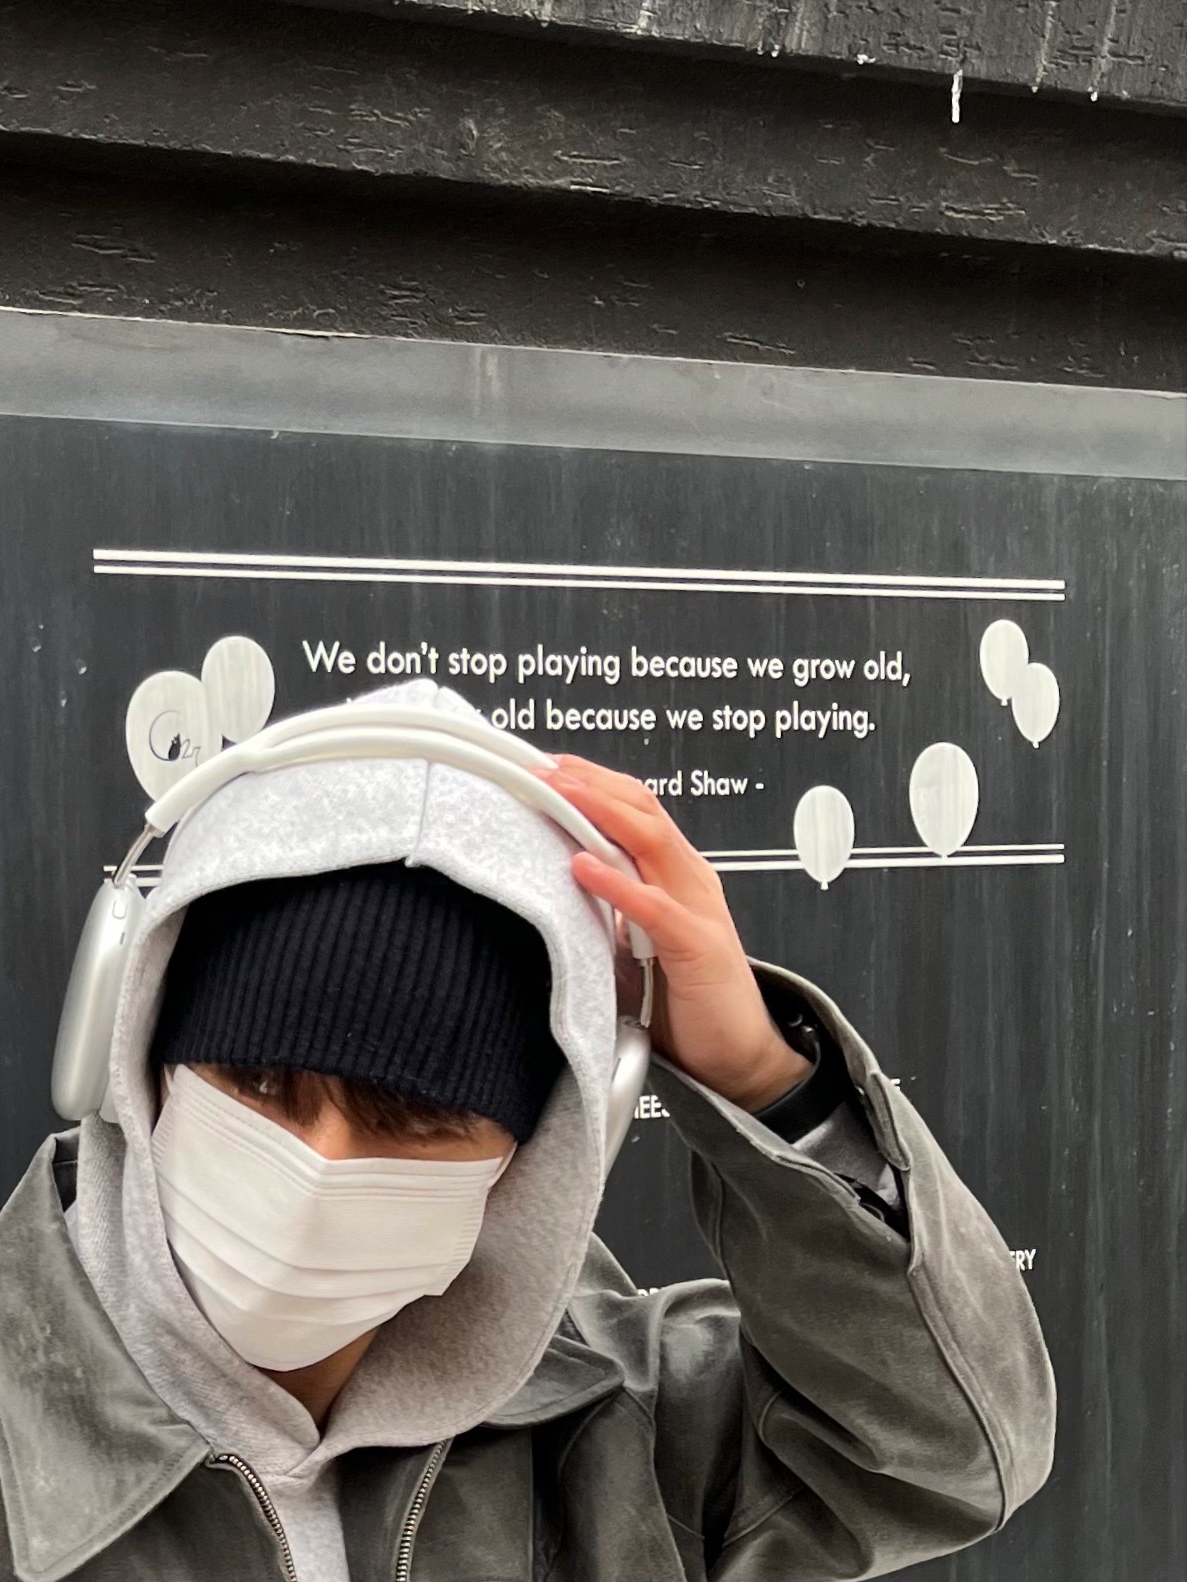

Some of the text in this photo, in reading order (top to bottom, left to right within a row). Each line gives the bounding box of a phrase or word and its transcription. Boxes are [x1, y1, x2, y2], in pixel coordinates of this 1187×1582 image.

[302, 640, 911, 687] We don't stop playing because we grow old,
[491, 698, 875, 739] old because we stop playing.
[690, 769, 748, 796] Shaw
